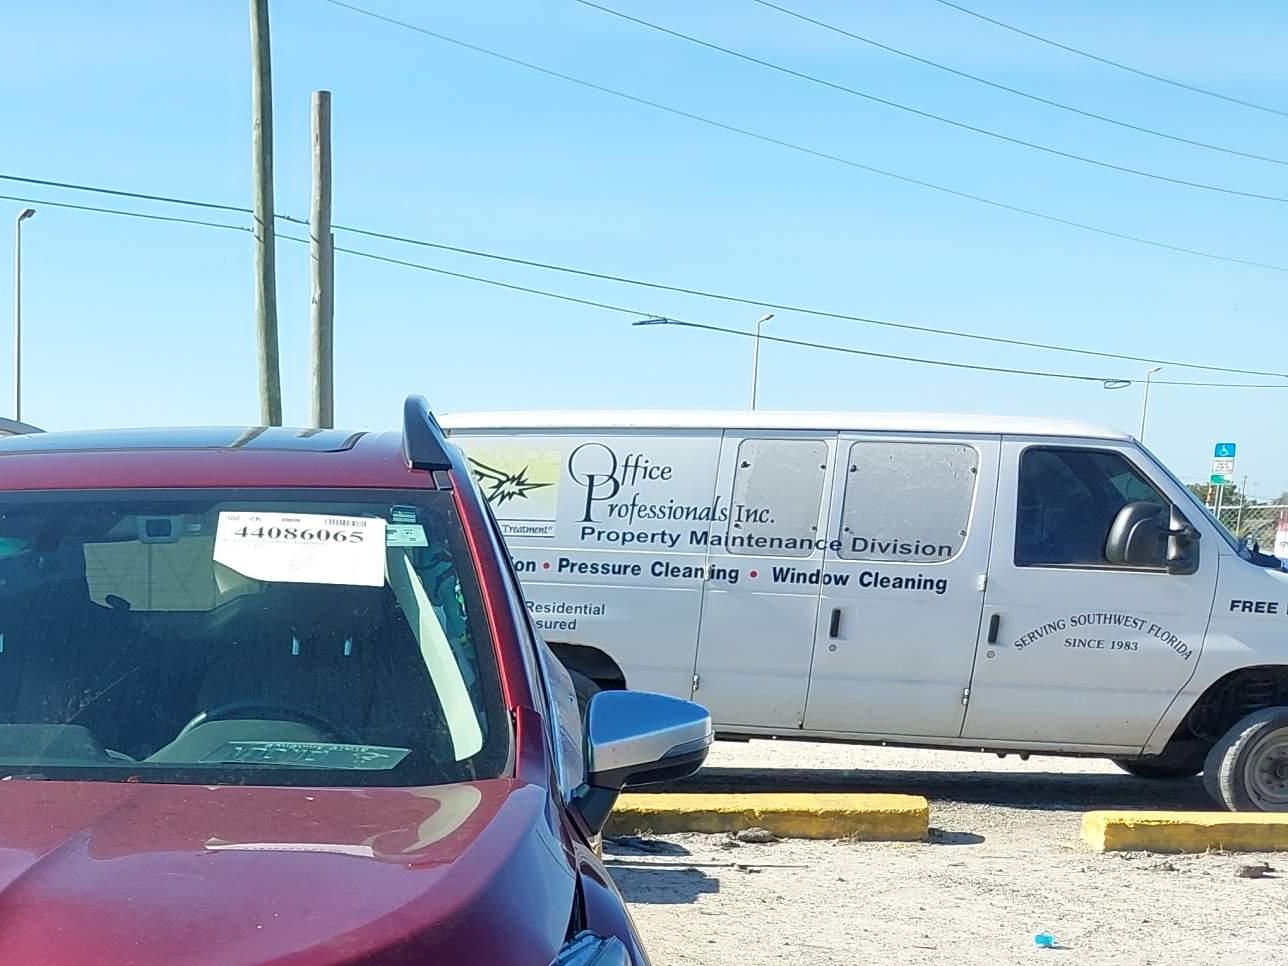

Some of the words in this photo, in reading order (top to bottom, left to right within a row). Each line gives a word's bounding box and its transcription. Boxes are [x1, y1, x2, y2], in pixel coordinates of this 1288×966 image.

[568, 443, 672, 486] Office
[574, 474, 728, 525] Professionals
[734, 504, 775, 524] Inc.
[234, 525, 364, 544] 44086065
[580, 526, 680, 547] Property
[689, 530, 842, 551] Maintenance
[851, 537, 953, 557] Division
[557, 557, 642, 576] Pressure
[650, 560, 740, 583] Cleaning
[772, 566, 850, 587] Window
[858, 571, 948, 594] Cleaning
[525, 601, 606, 615] Residential
[1230, 599, 1279, 614] FREE
[1014, 618, 1066, 652] SERVING
[1070, 612, 1148, 631] SOUTHWEST
[1147, 624, 1194, 661] FLORIDA
[1063, 637, 1105, 650] SINCE
[1110, 639, 1139, 652] 1983
